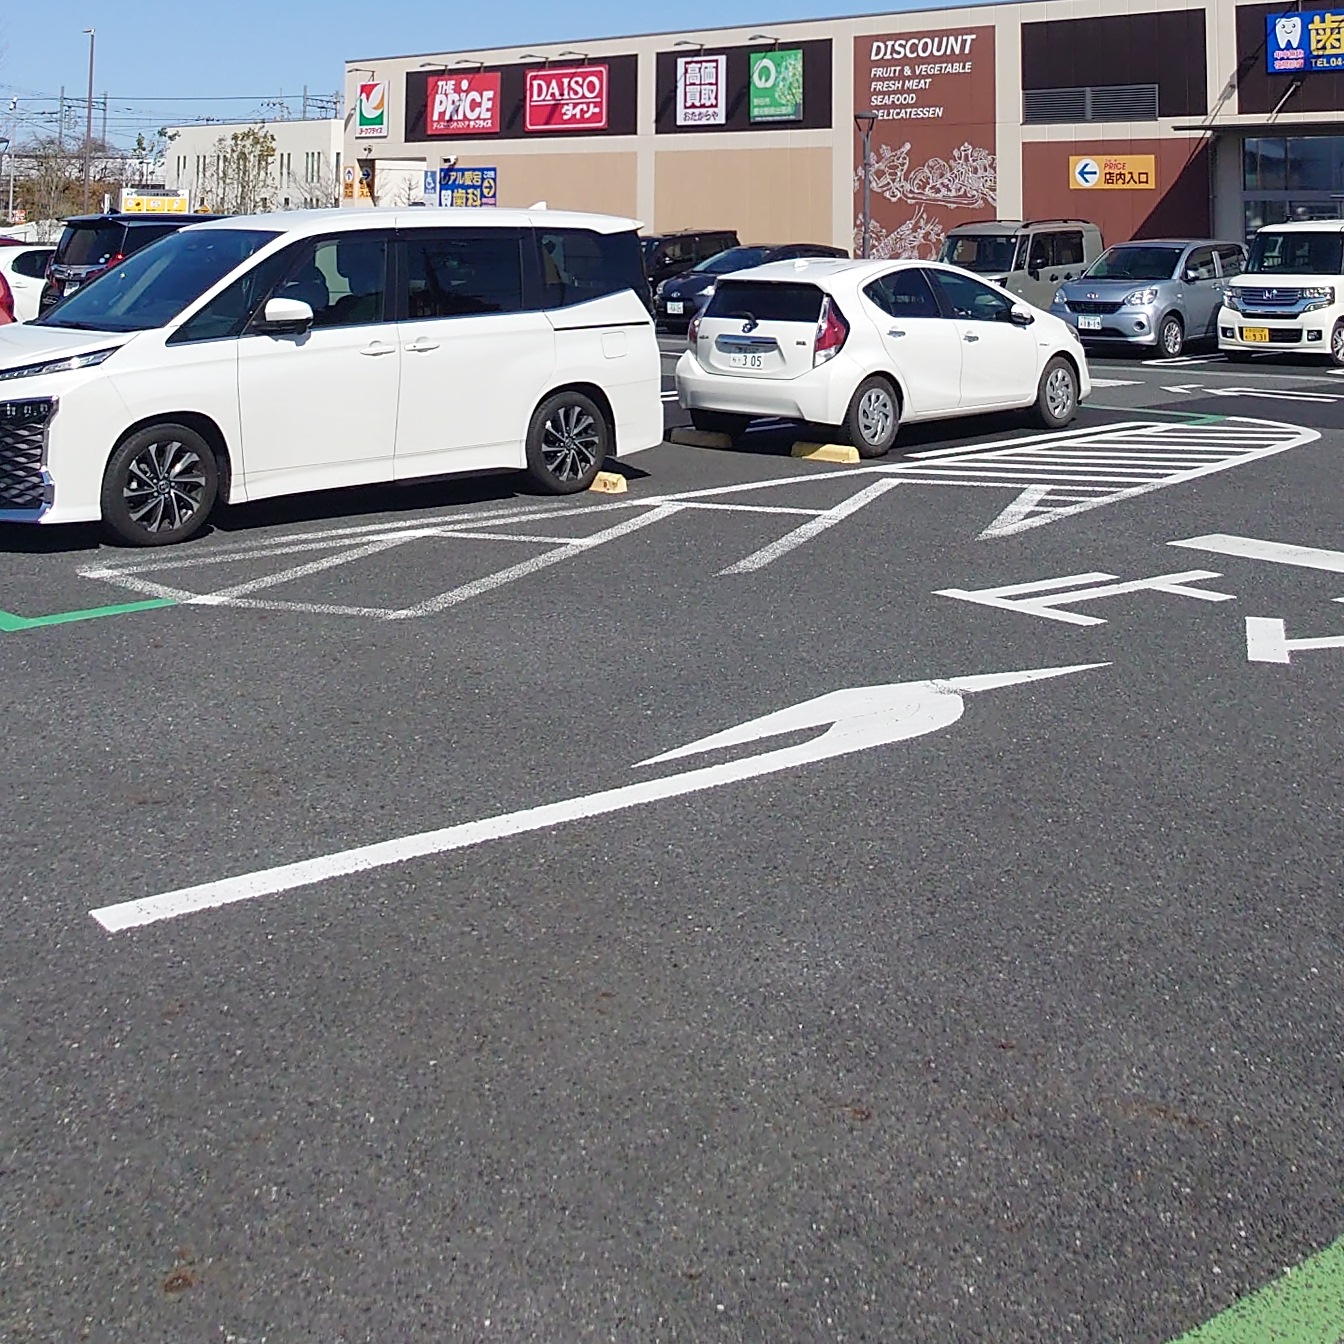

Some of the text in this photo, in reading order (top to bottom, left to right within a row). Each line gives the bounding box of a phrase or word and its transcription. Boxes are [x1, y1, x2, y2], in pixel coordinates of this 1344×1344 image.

[870, 34, 976, 61] DISCOUNT
[685, 62, 717, 84] 高価
[870, 62, 972, 78] FRUIT & VEGETABLE
[437, 81, 455, 94] THE
[531, 76, 600, 101] DAISO
[870, 78, 932, 92] FRESH MEAT
[685, 85, 717, 108] 買取
[870, 94, 916, 106] SEAFOOD
[562, 103, 600, 120] ダイソー
[683, 109, 718, 121] おたからや
[1104, 171, 1149, 185] 店内入口
